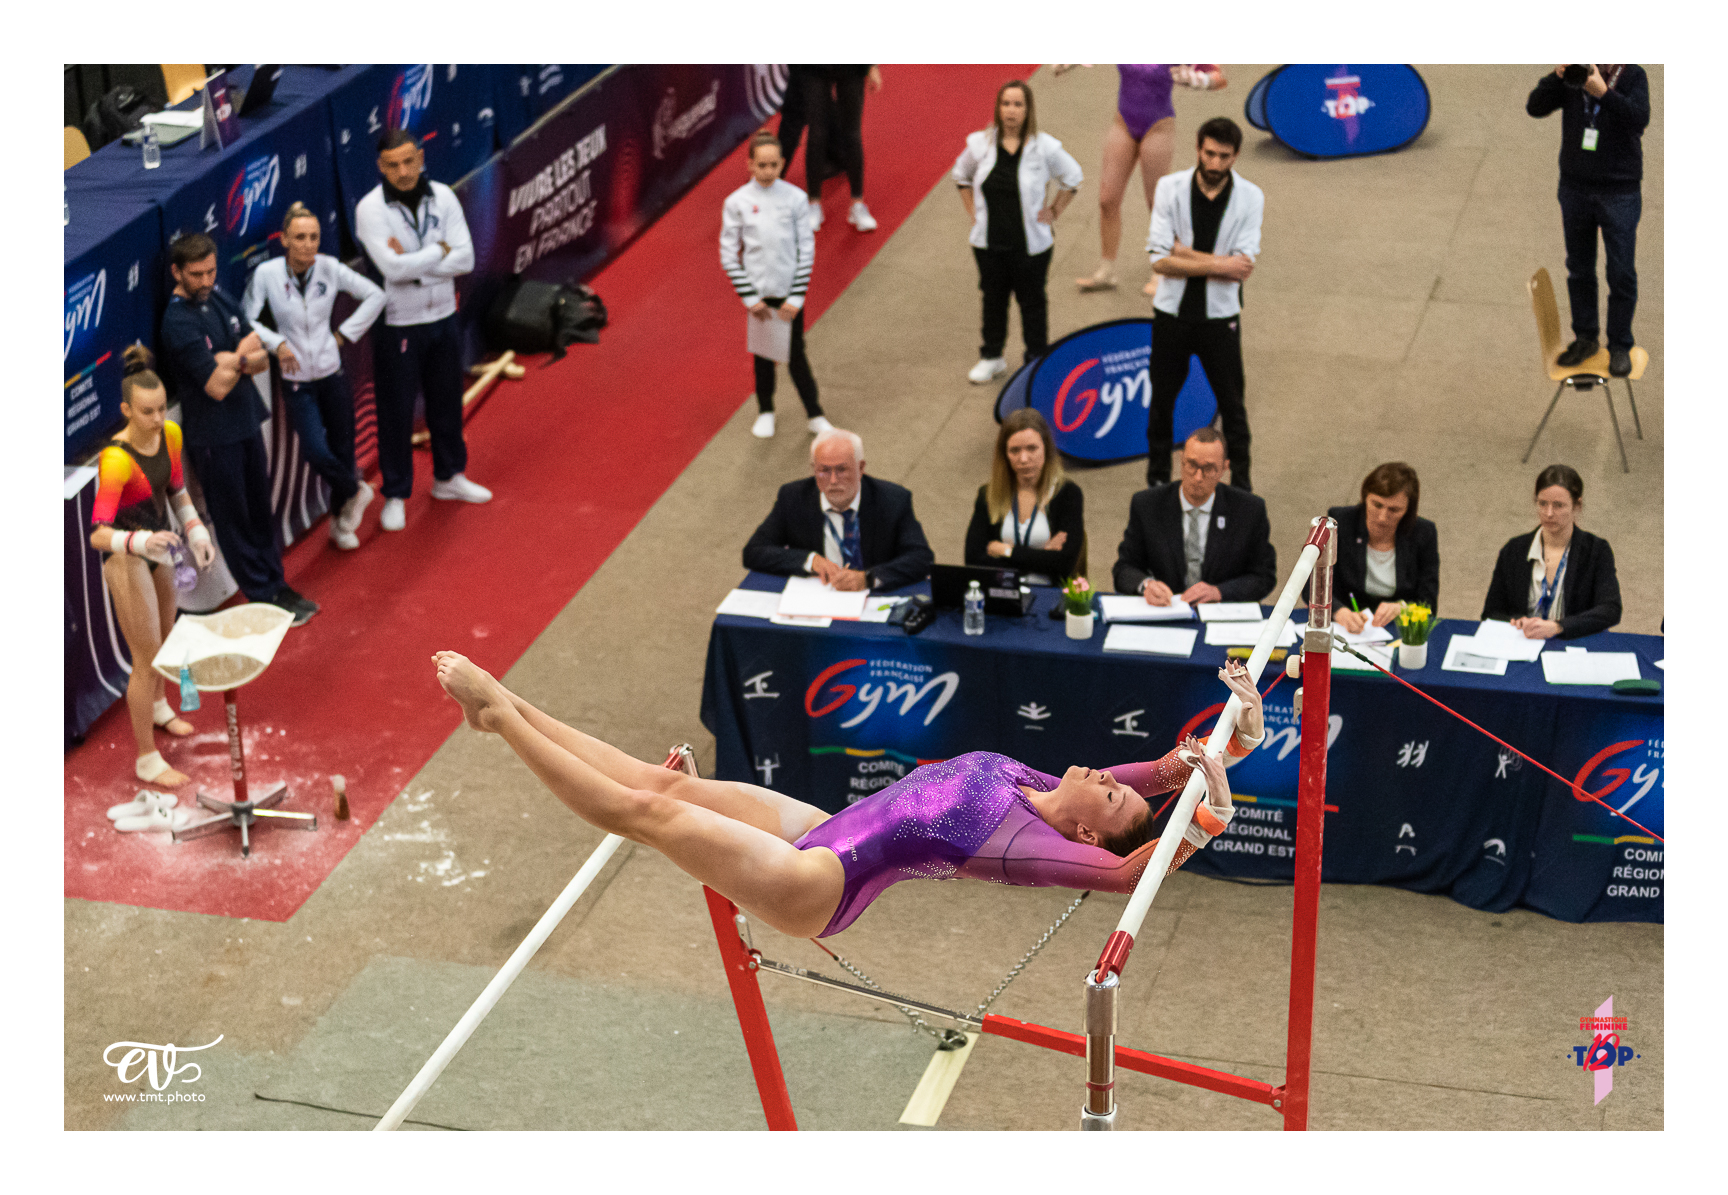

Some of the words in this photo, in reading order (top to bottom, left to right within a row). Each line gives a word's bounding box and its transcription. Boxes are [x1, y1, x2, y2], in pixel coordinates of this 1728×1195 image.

[553, 147, 576, 189] LES
[513, 238, 538, 274] EN
[64, 268, 107, 362] ym
[870, 659, 933, 673] FÉDÉRATION
[870, 669, 924, 683] FRANÇAISE
[805, 659, 960, 728] Gym
[850, 776, 896, 791] RÉGIO
[1572, 739, 1664, 816] Gy
[1224, 821, 1292, 841] ÉGIONAL
[1212, 839, 1265, 855] GRAND
[1268, 845, 1297, 858] EST
[1624, 848, 1664, 863] COMI
[1612, 864, 1664, 880] RÉGIO
[1607, 884, 1660, 898] GRAND
